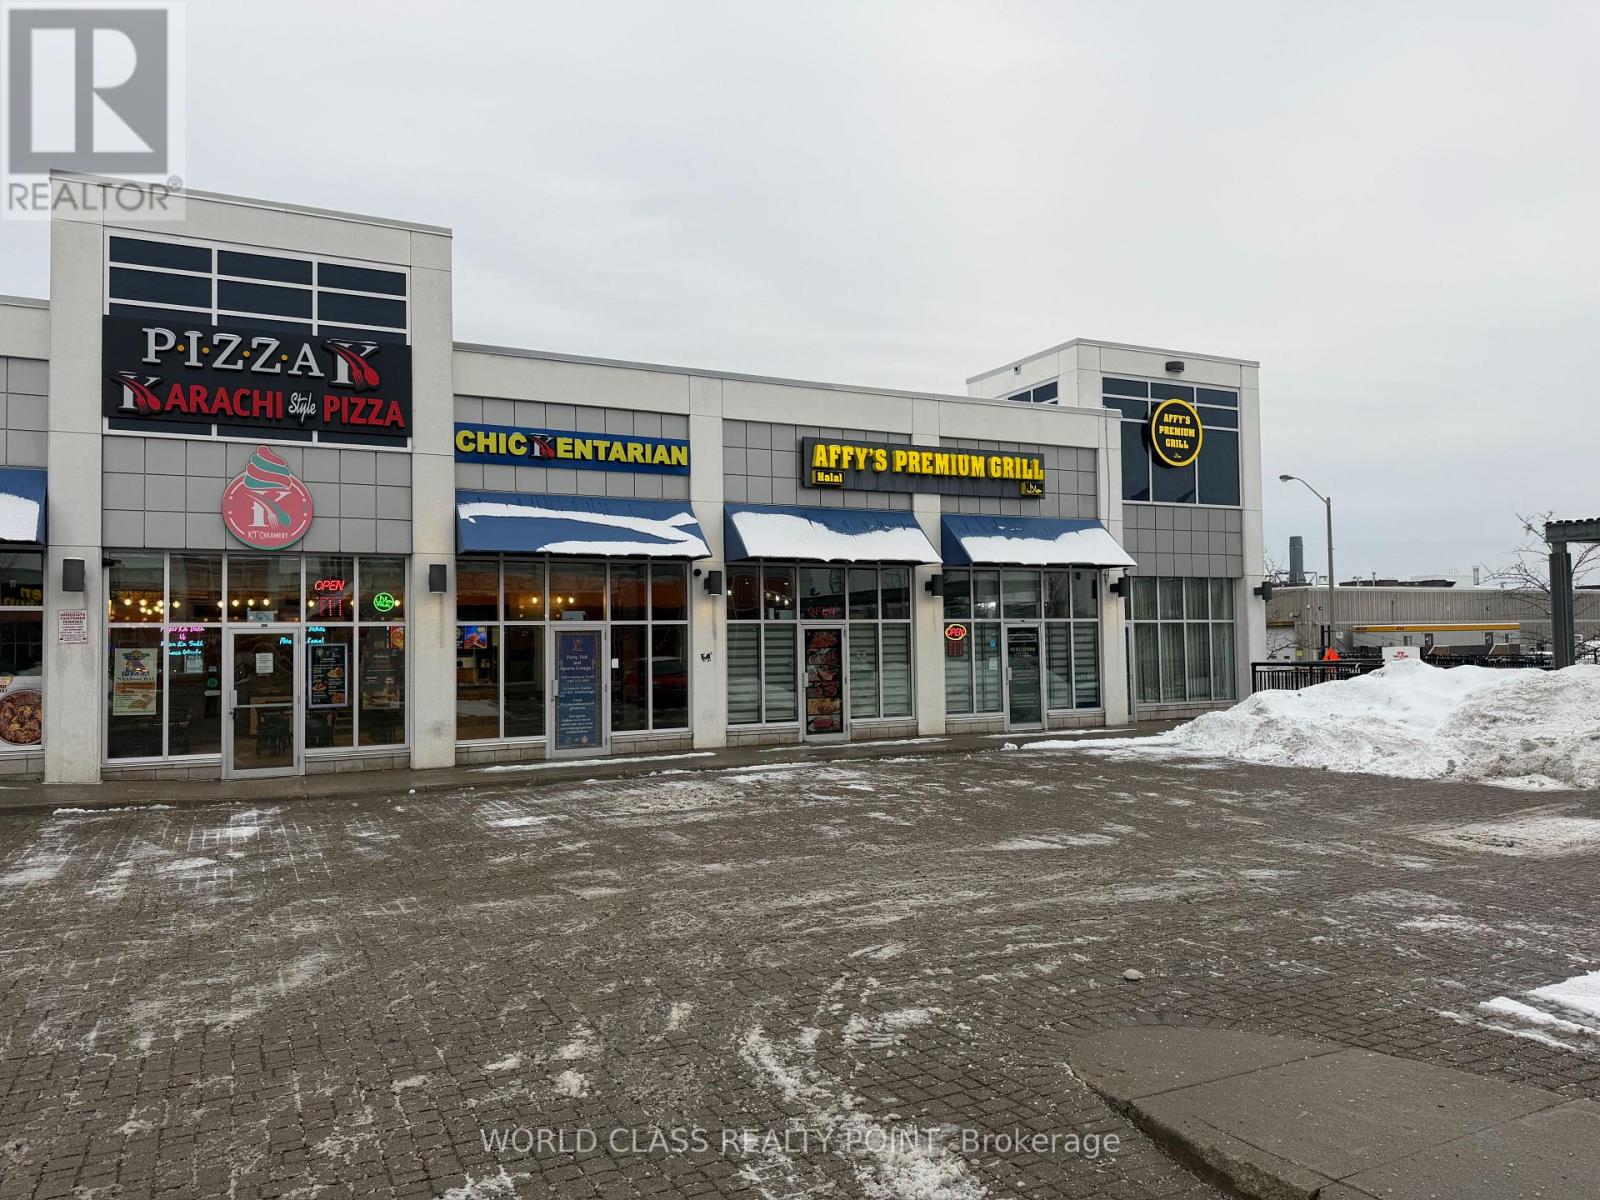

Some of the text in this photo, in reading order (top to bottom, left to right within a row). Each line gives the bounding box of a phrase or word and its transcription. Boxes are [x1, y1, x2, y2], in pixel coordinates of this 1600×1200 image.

[288, 391, 316, 422] Style
[323, 394, 405, 428] PIZZA
[1163, 413, 1191, 425] AFFY'S
[1158, 425, 1196, 437] PREMIUM
[1165, 438, 1189, 449] GRILL
[811, 444, 1044, 481] AFFY'S PREMIUM GRILL
[816, 471, 843, 483] Halal
[314, 580, 345, 591] OPEN
[946, 627, 965, 637] OPEN
